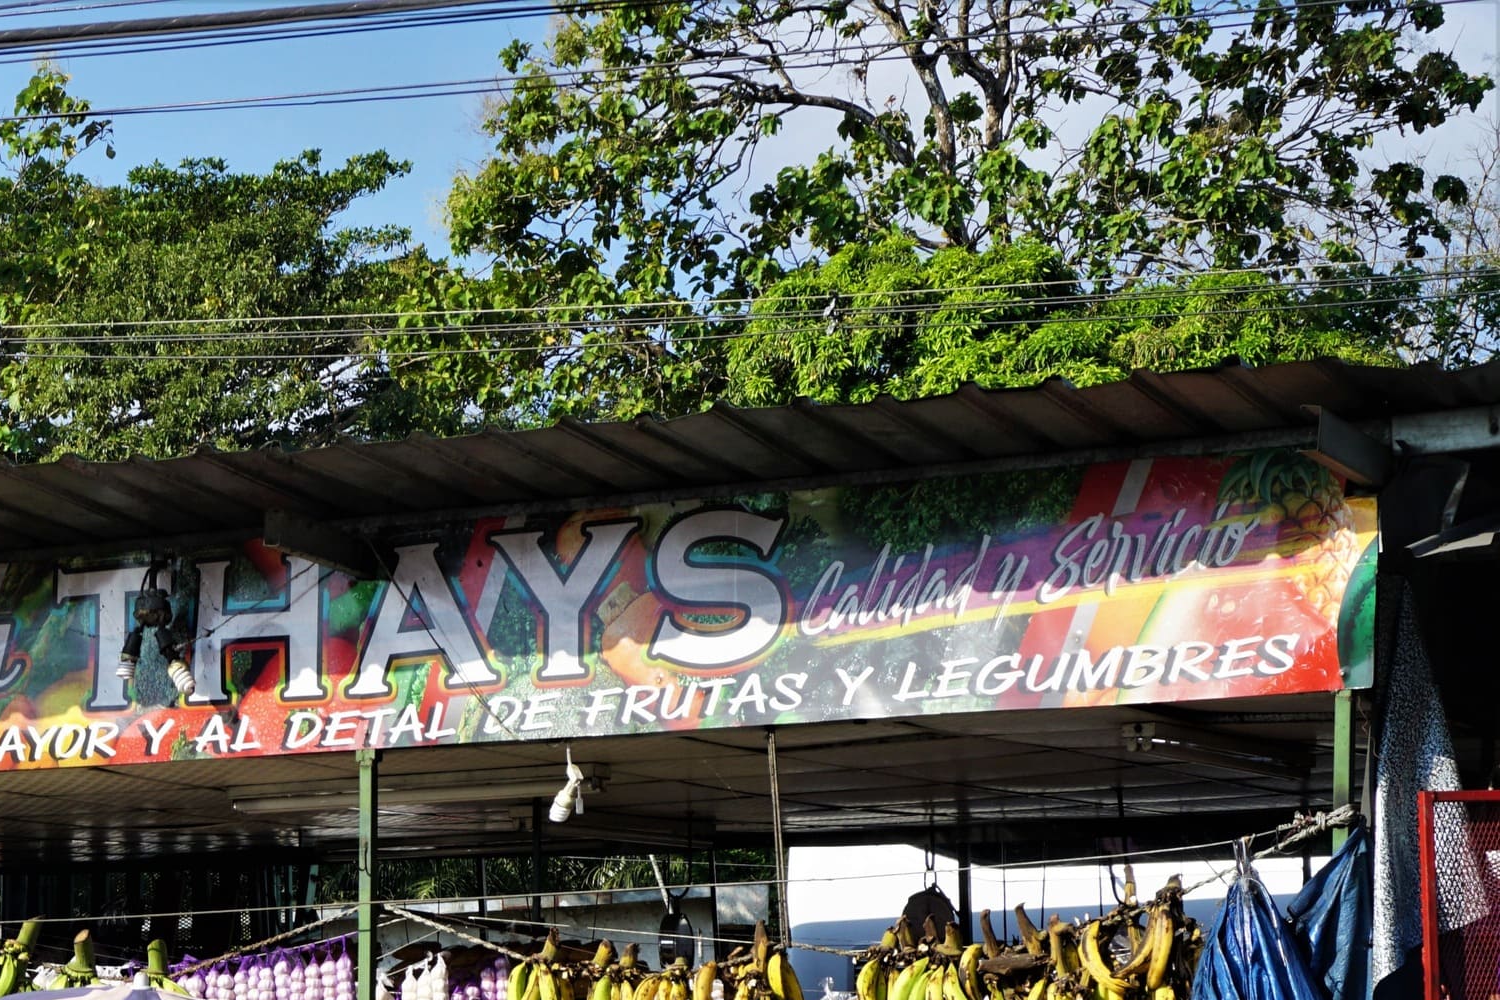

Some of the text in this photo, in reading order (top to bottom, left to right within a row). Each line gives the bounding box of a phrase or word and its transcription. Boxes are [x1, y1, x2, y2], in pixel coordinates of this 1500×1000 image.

[57, 509, 790, 708] THAYS
[801, 503, 1261, 636] Calidad y Servicio
[141, 718, 175, 756] Y
[196, 714, 260, 752] AL
[285, 702, 456, 749] DETAL
[484, 690, 556, 734] DE
[585, 673, 806, 727] FRUTAS
[838, 667, 877, 701] Y
[891, 634, 1301, 702] LEGUMBRES
